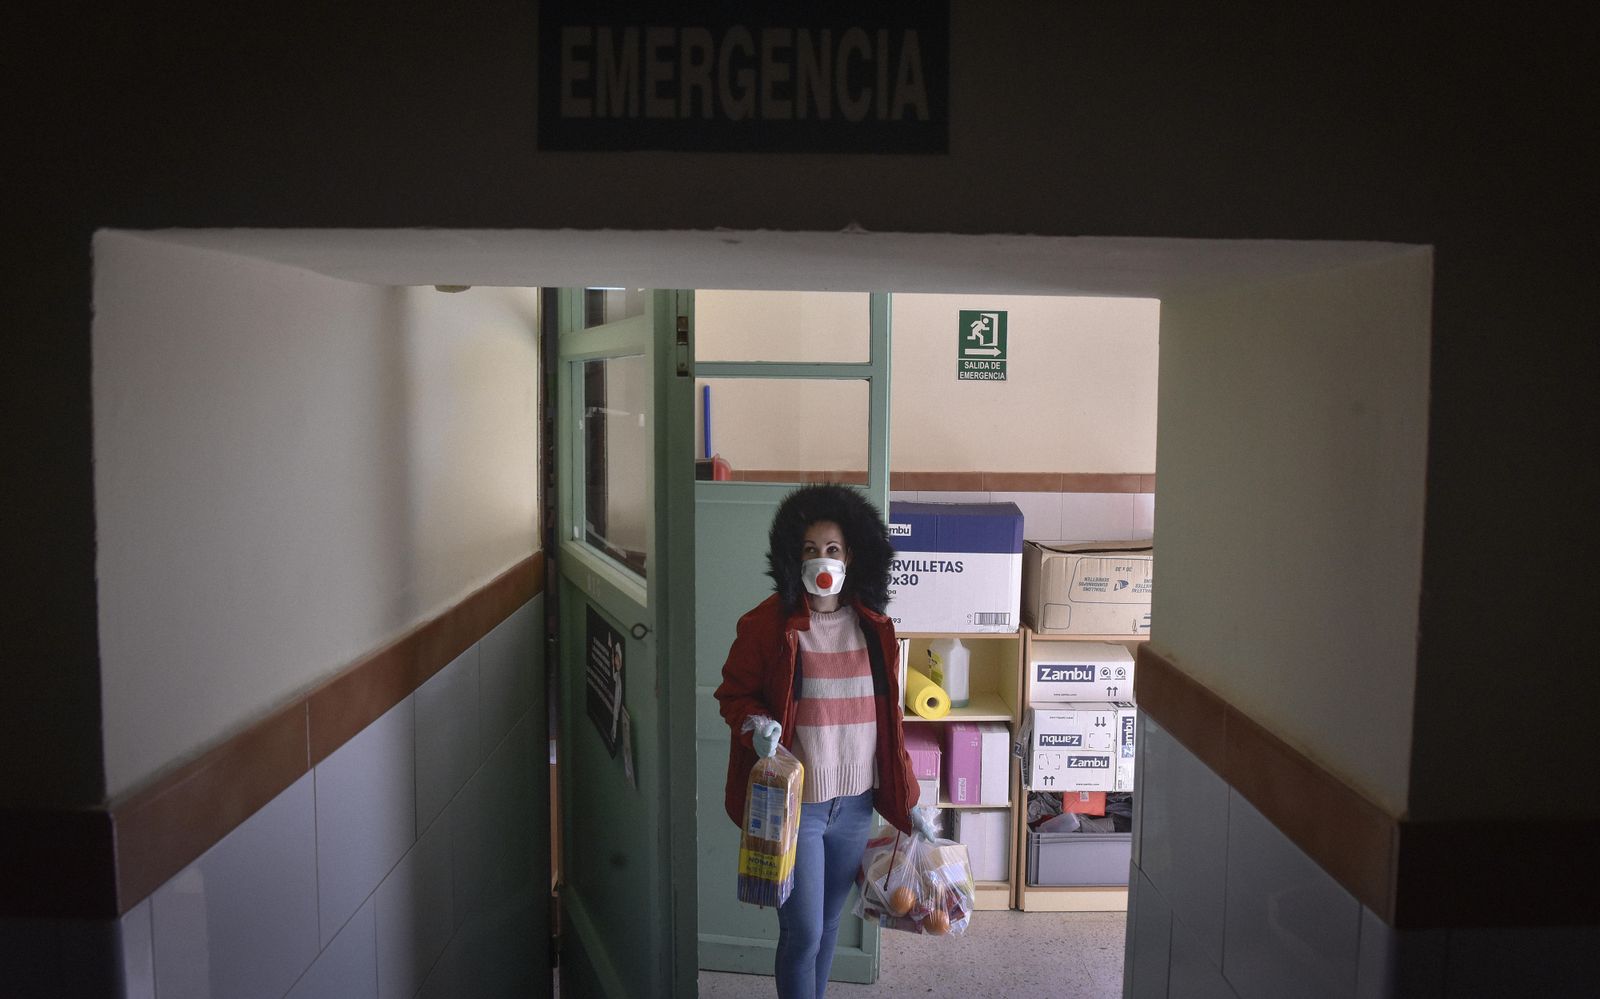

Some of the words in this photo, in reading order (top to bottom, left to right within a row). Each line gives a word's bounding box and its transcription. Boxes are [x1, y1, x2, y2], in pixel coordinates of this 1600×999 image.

[560, 24, 931, 123] EMERGENCIA
[964, 361, 989, 370] SALIDA
[991, 361, 1001, 370] DE
[959, 371, 1006, 380] EMERGENCIA
[889, 523, 910, 535] mbú
[889, 559, 964, 573] RVILLETAS
[885, 573, 919, 586] 0x30
[1040, 664, 1093, 681] Zambú
[1041, 735, 1080, 747] Zambú
[1122, 717, 1134, 757] Zambú
[1069, 756, 1108, 768] Zambú
